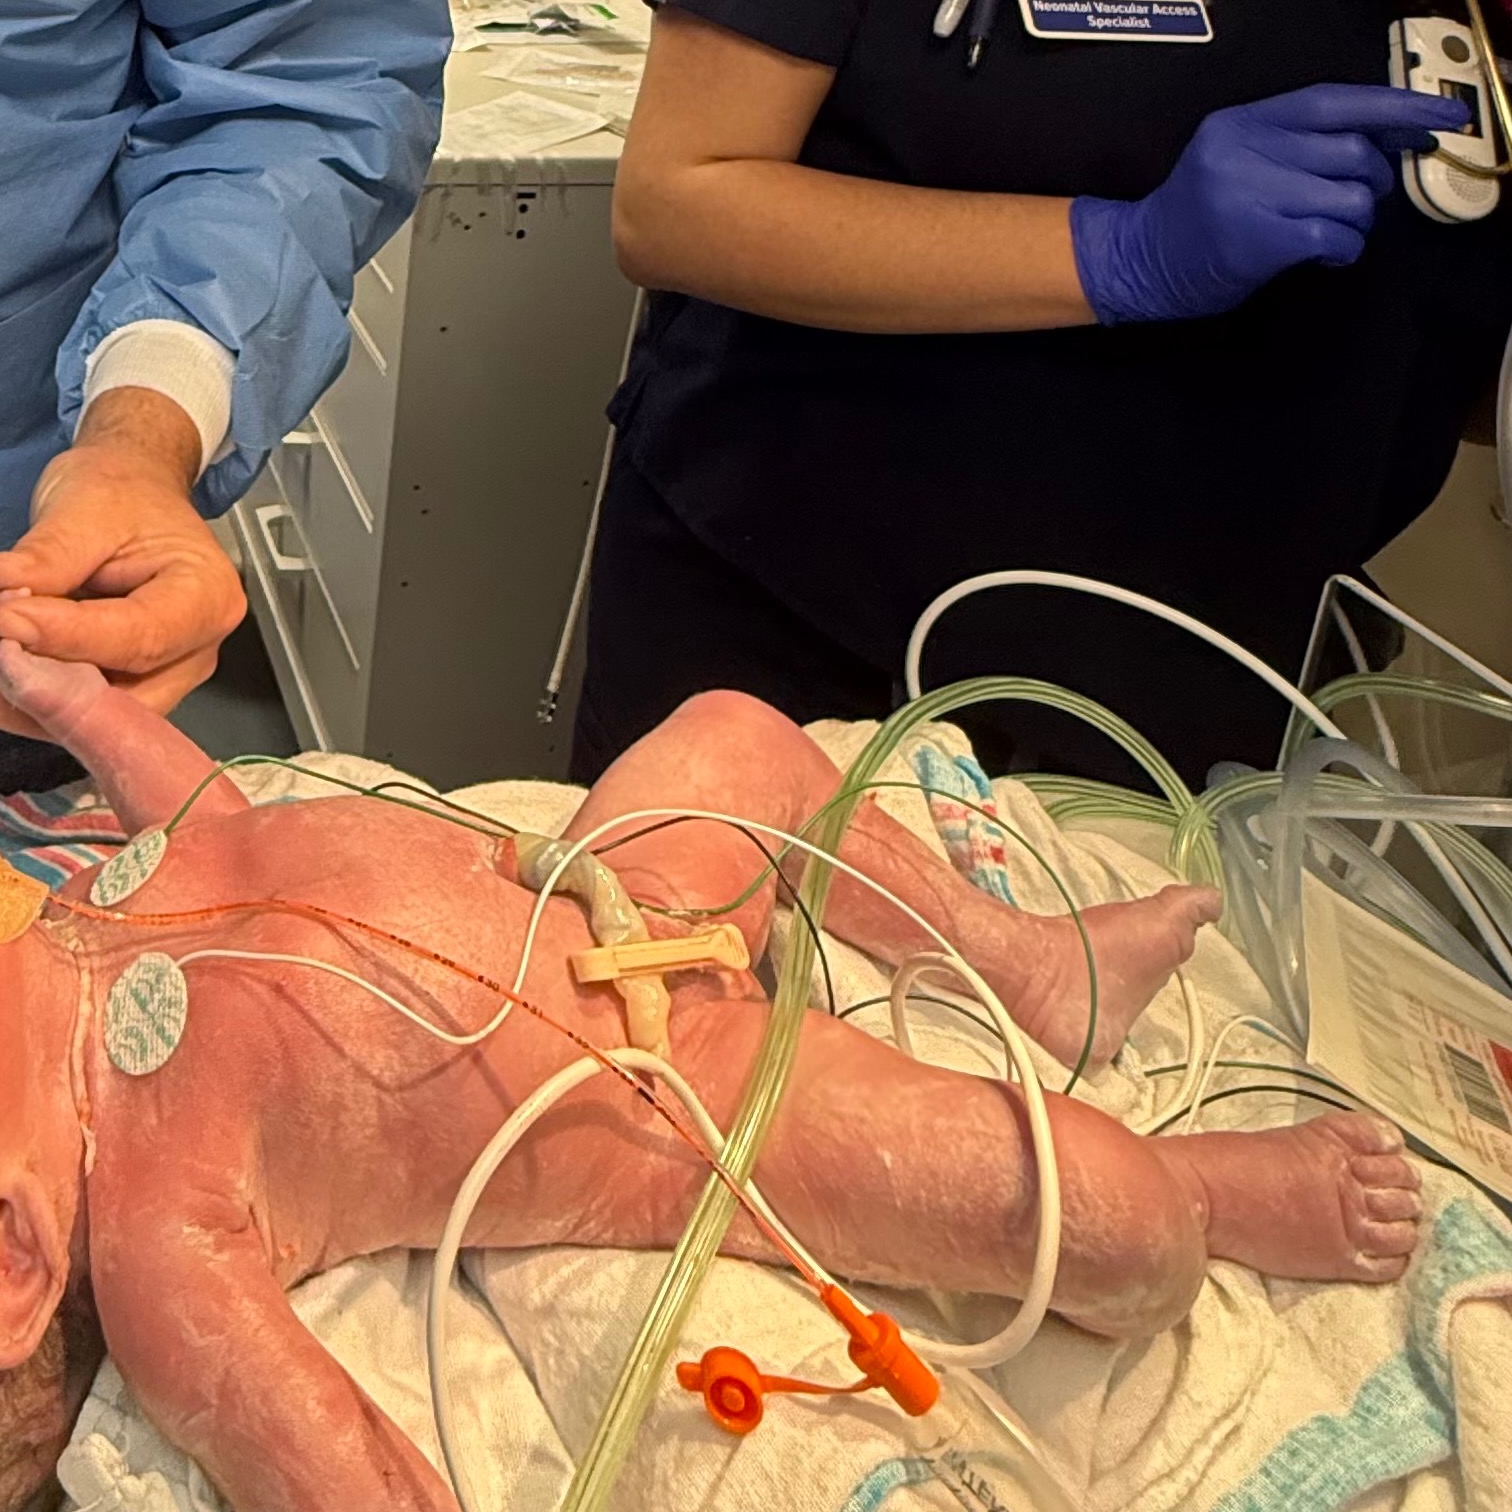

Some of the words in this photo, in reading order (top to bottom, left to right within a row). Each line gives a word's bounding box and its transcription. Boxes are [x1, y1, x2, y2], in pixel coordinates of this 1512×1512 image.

[1032, 0, 1092, 13] Neonatal
[1092, 1, 1149, 15] Vascular
[1152, 2, 1198, 16] Access
[1086, 14, 1152, 30] Specialist
